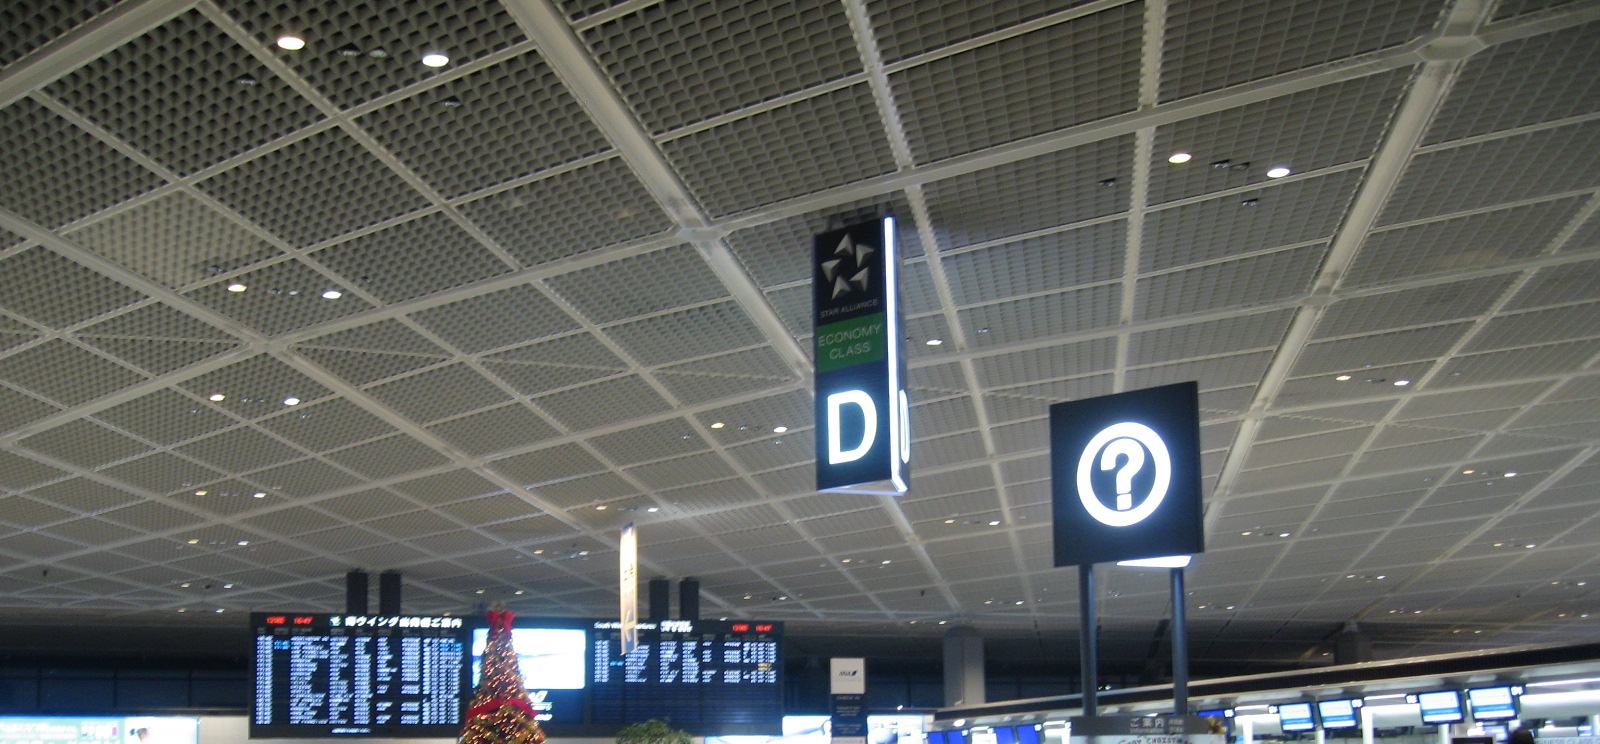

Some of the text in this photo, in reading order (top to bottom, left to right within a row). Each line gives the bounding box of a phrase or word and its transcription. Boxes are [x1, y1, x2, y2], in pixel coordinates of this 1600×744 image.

[820, 298, 879, 319] STAR ALLIANCE
[818, 324, 882, 347] ECONOMY
[829, 341, 871, 360] CLASS
[827, 389, 878, 465] D
